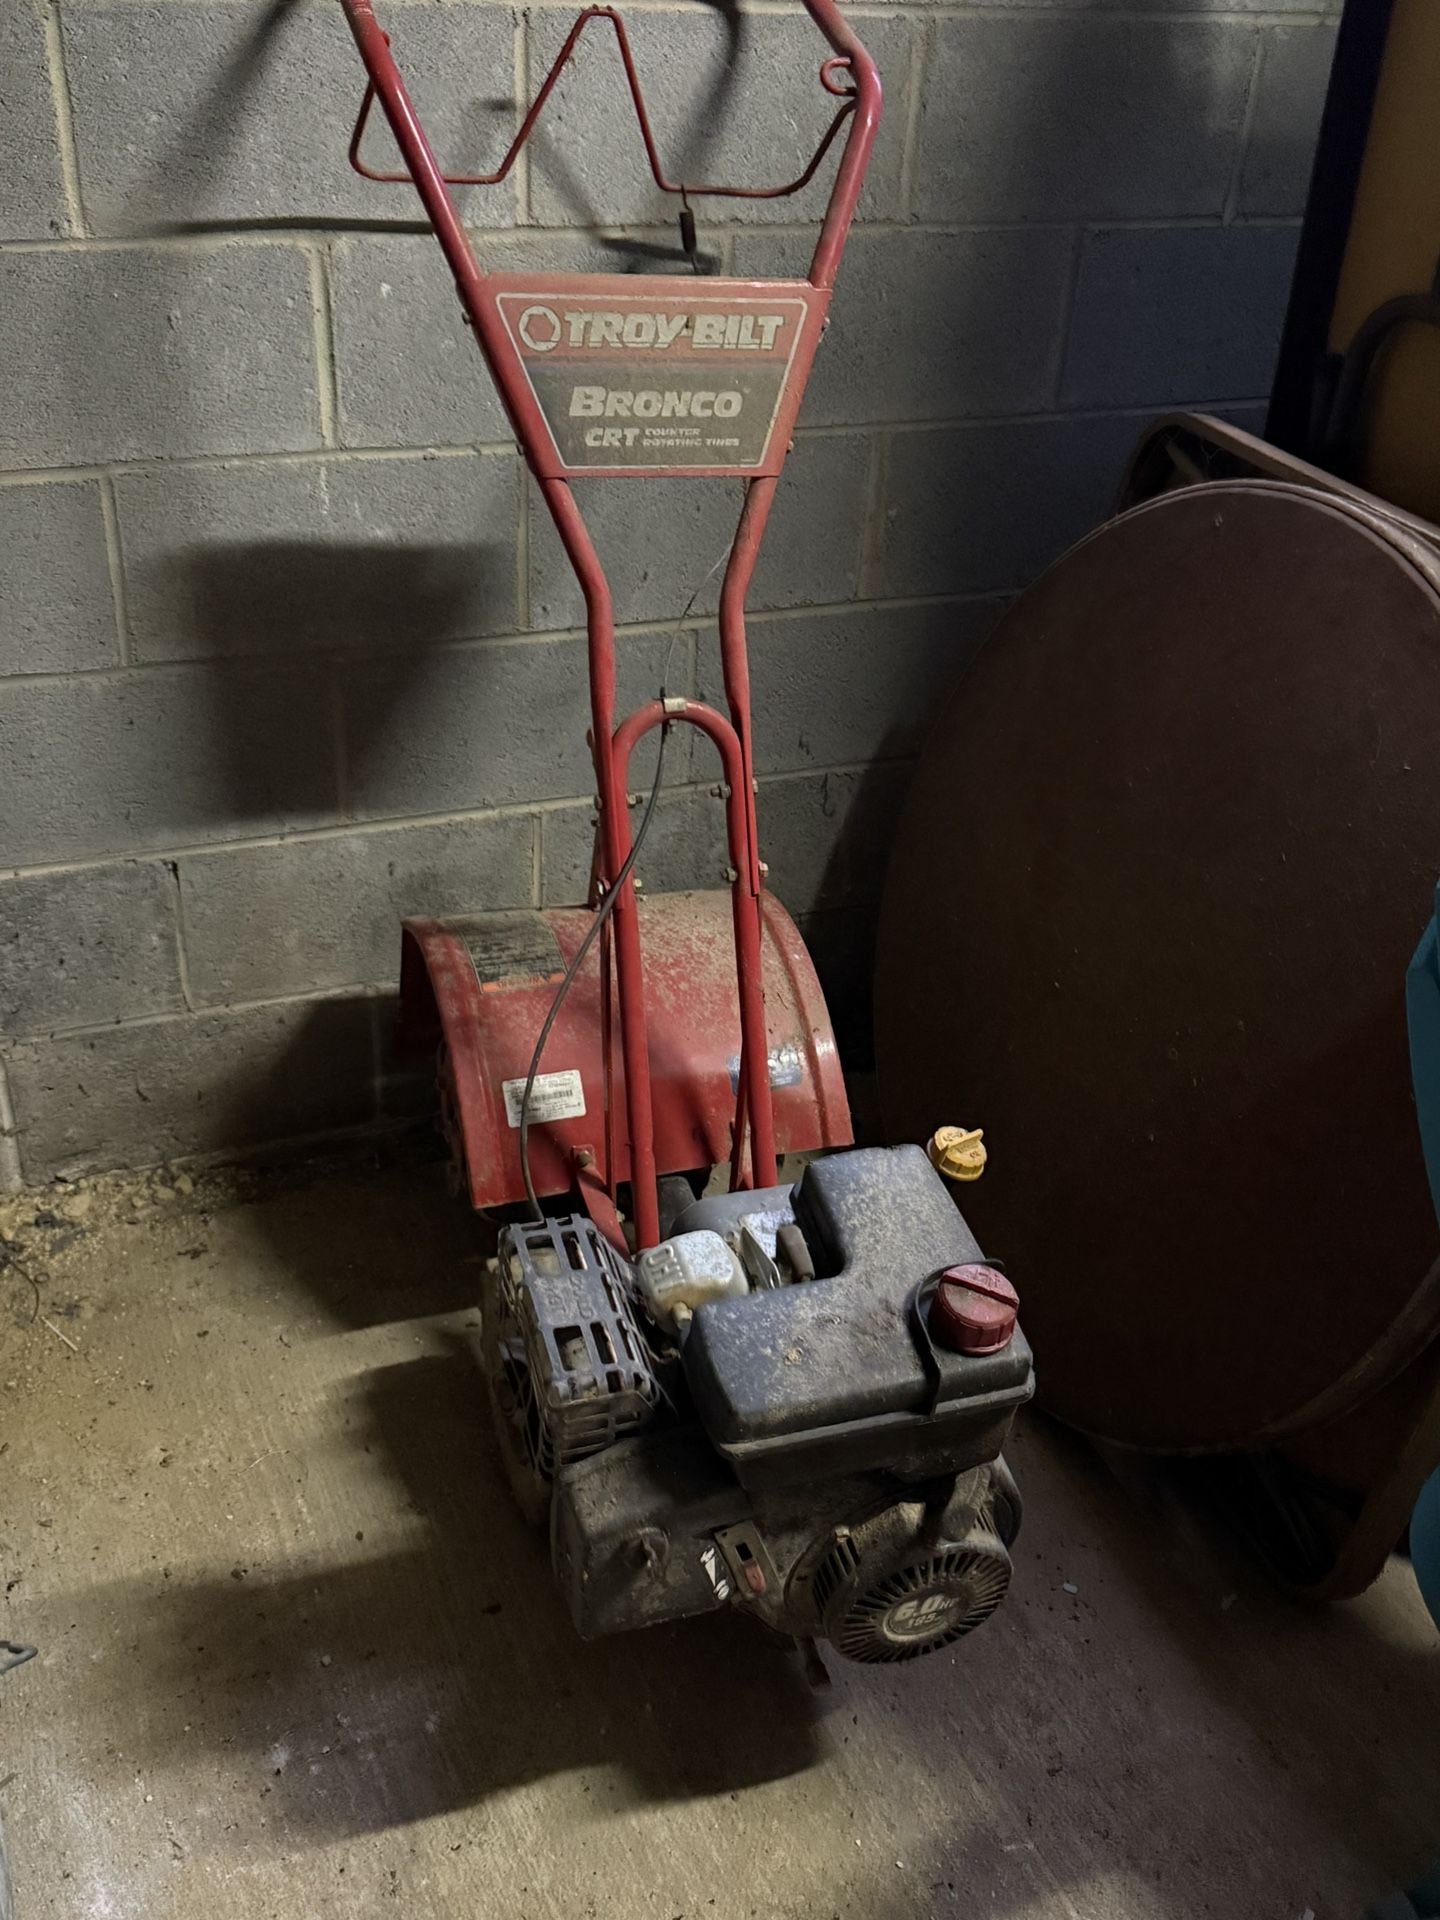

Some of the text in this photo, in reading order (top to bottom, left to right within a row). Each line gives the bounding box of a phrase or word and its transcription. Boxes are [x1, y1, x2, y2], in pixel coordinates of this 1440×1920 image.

[564, 311, 784, 350] TROY-BILT
[569, 386, 743, 417] BRONCO
[585, 427, 640, 447] CRT
[645, 427, 701, 437] COUNTER
[643, 437, 741, 448] ROTATING TINES
